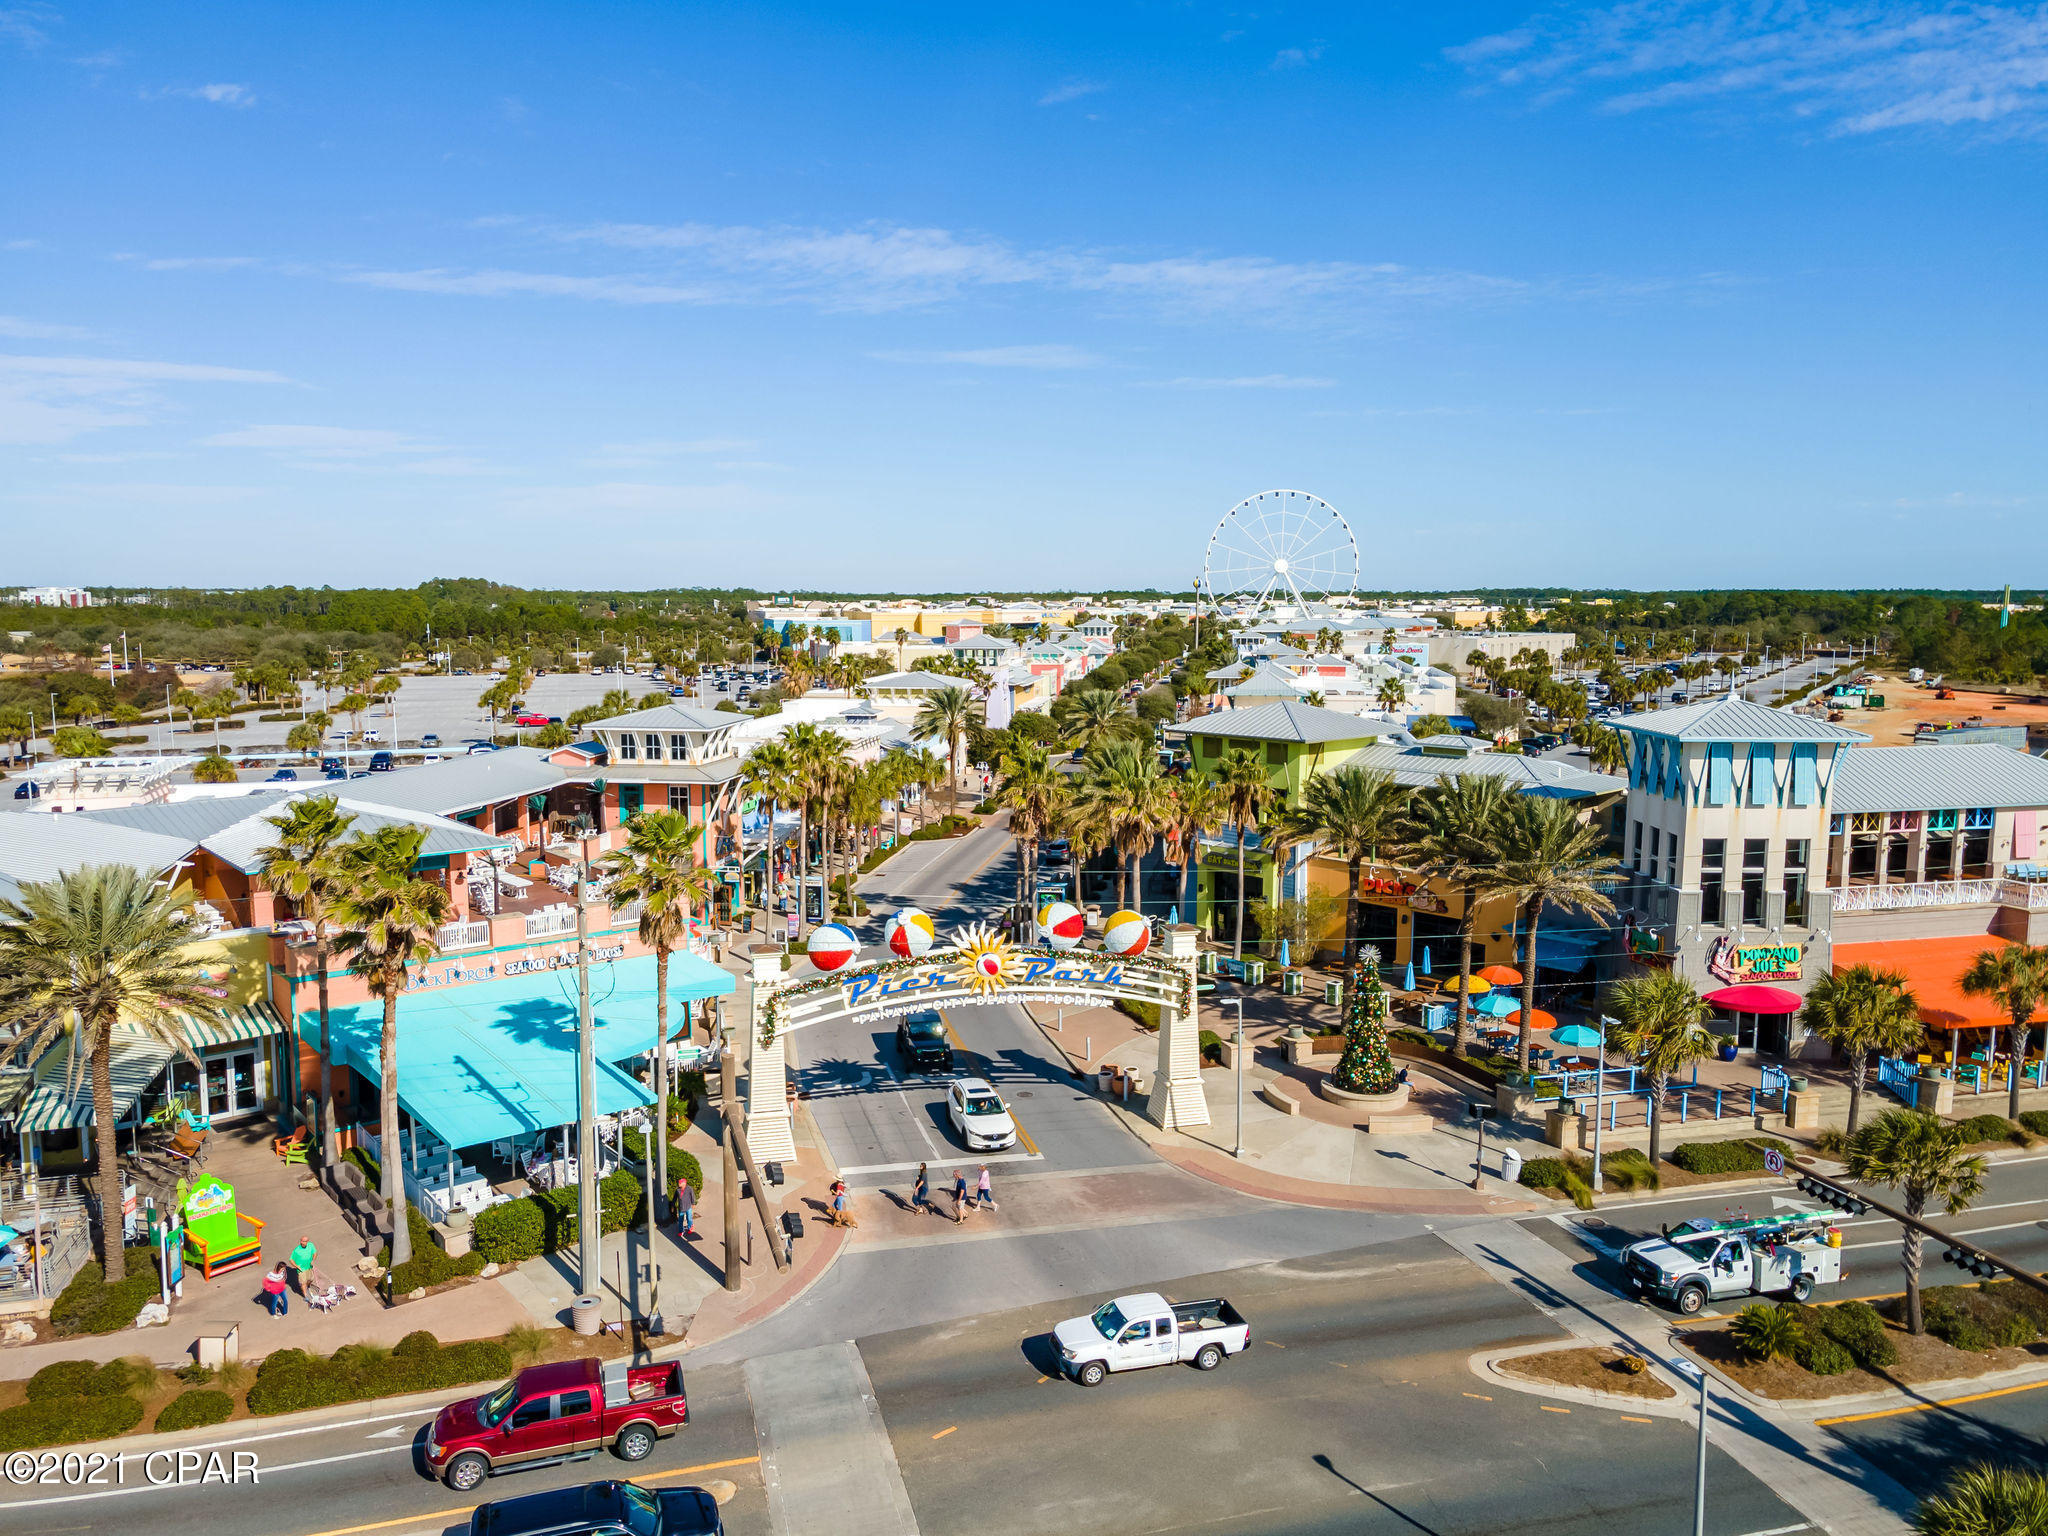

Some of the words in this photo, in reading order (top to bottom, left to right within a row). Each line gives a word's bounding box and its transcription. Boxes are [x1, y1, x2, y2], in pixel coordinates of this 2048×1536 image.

[505, 958, 546, 976] SEAFOOD
[595, 945, 623, 960] HOUSE
[1738, 947, 1799, 966] POMPANO
[839, 970, 959, 1005] Pier
[1020, 956, 1137, 988] Park
[858, 1003, 927, 1025] PANAMA
[932, 997, 969, 1011] CITY
[976, 993, 1026, 1006] BEACH
[1045, 995, 1109, 1008] FLORIDA
